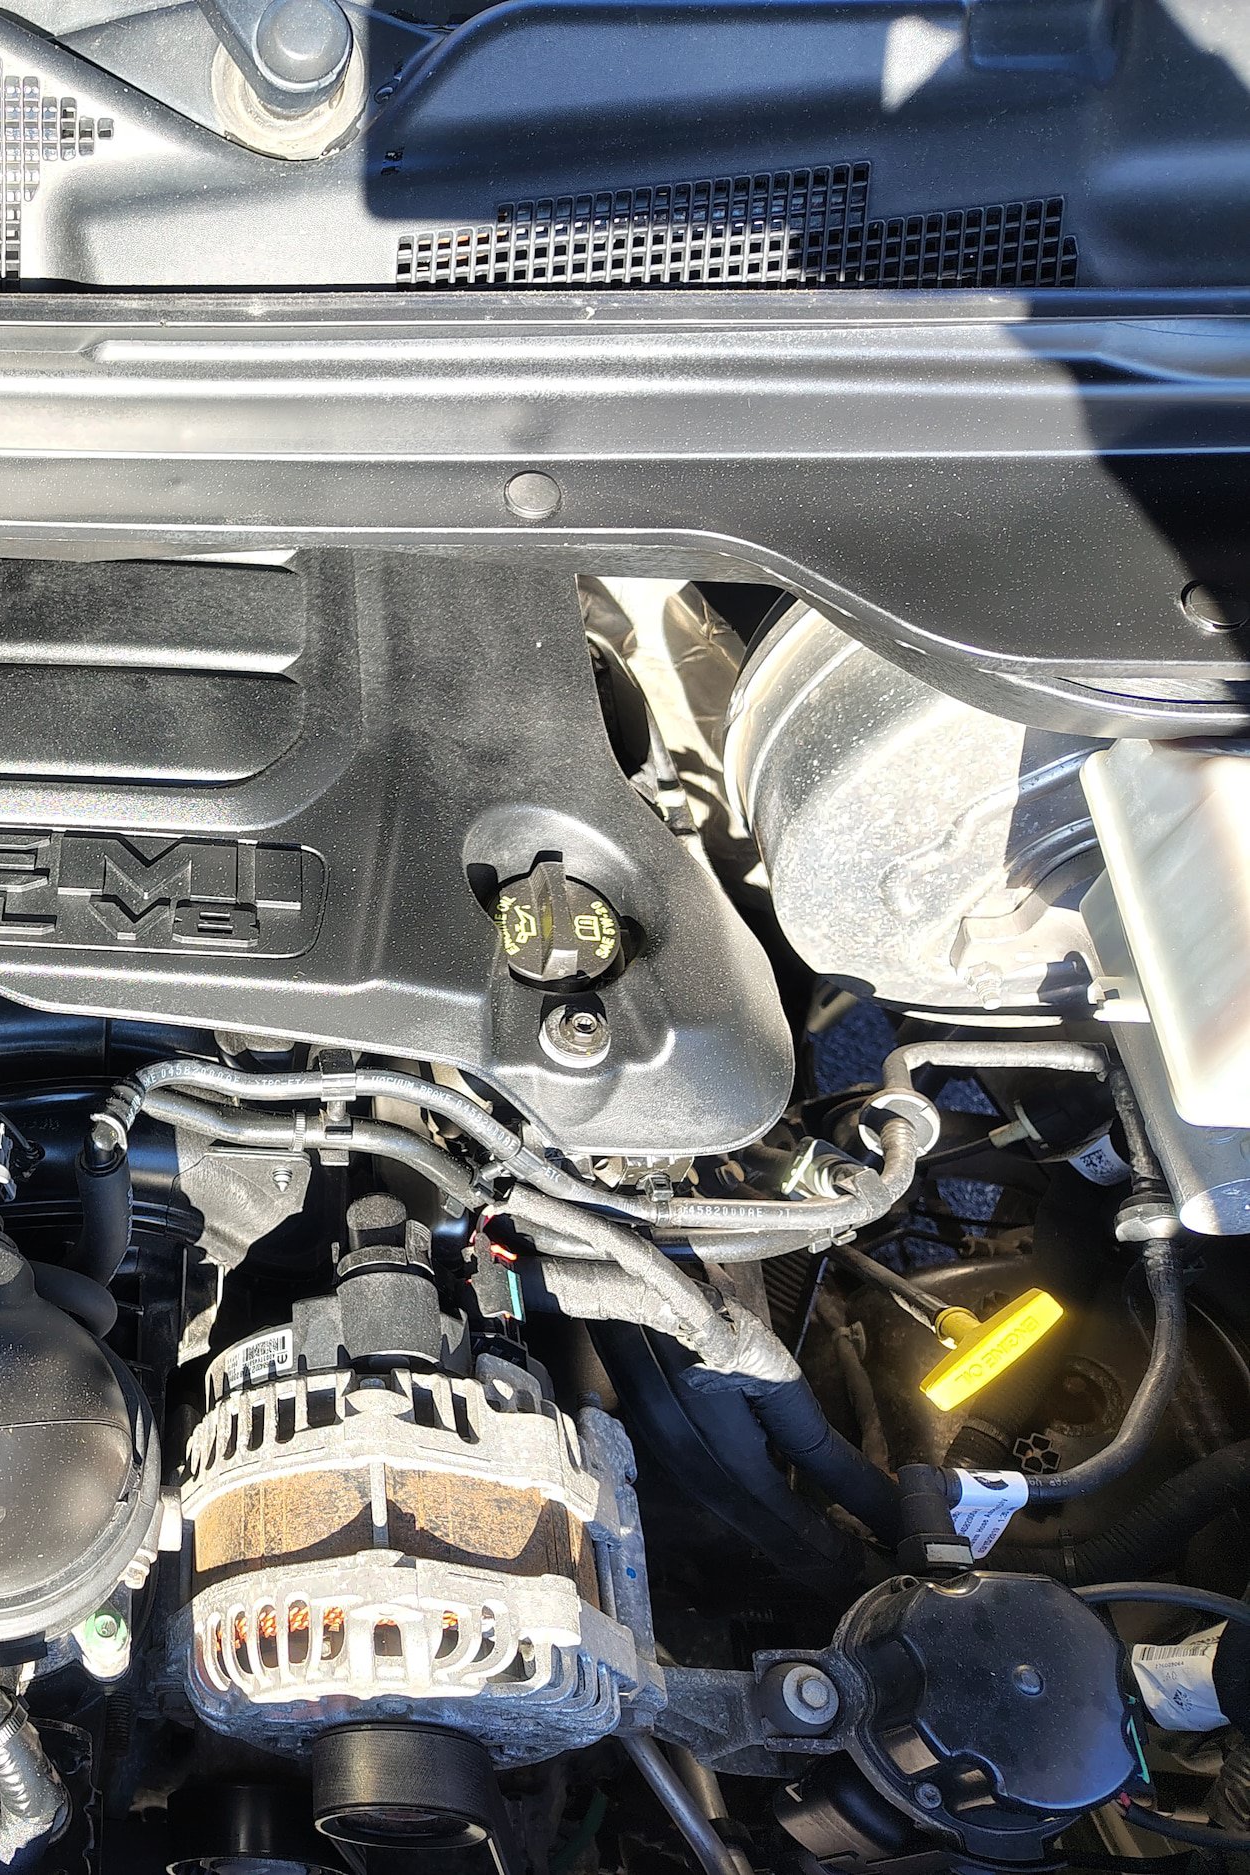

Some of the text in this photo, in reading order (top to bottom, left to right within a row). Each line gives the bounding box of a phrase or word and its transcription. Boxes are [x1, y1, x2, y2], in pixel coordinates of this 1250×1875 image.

[86, 896, 260, 948] V8
[590, 901, 617, 959] SAE 5W-20
[371, 1075, 415, 1091] VACUUM
[420, 1085, 454, 1103] BRAKE
[455, 1099, 519, 1150] 04582000AE
[953, 1315, 1039, 1385] ENGINE OIL
